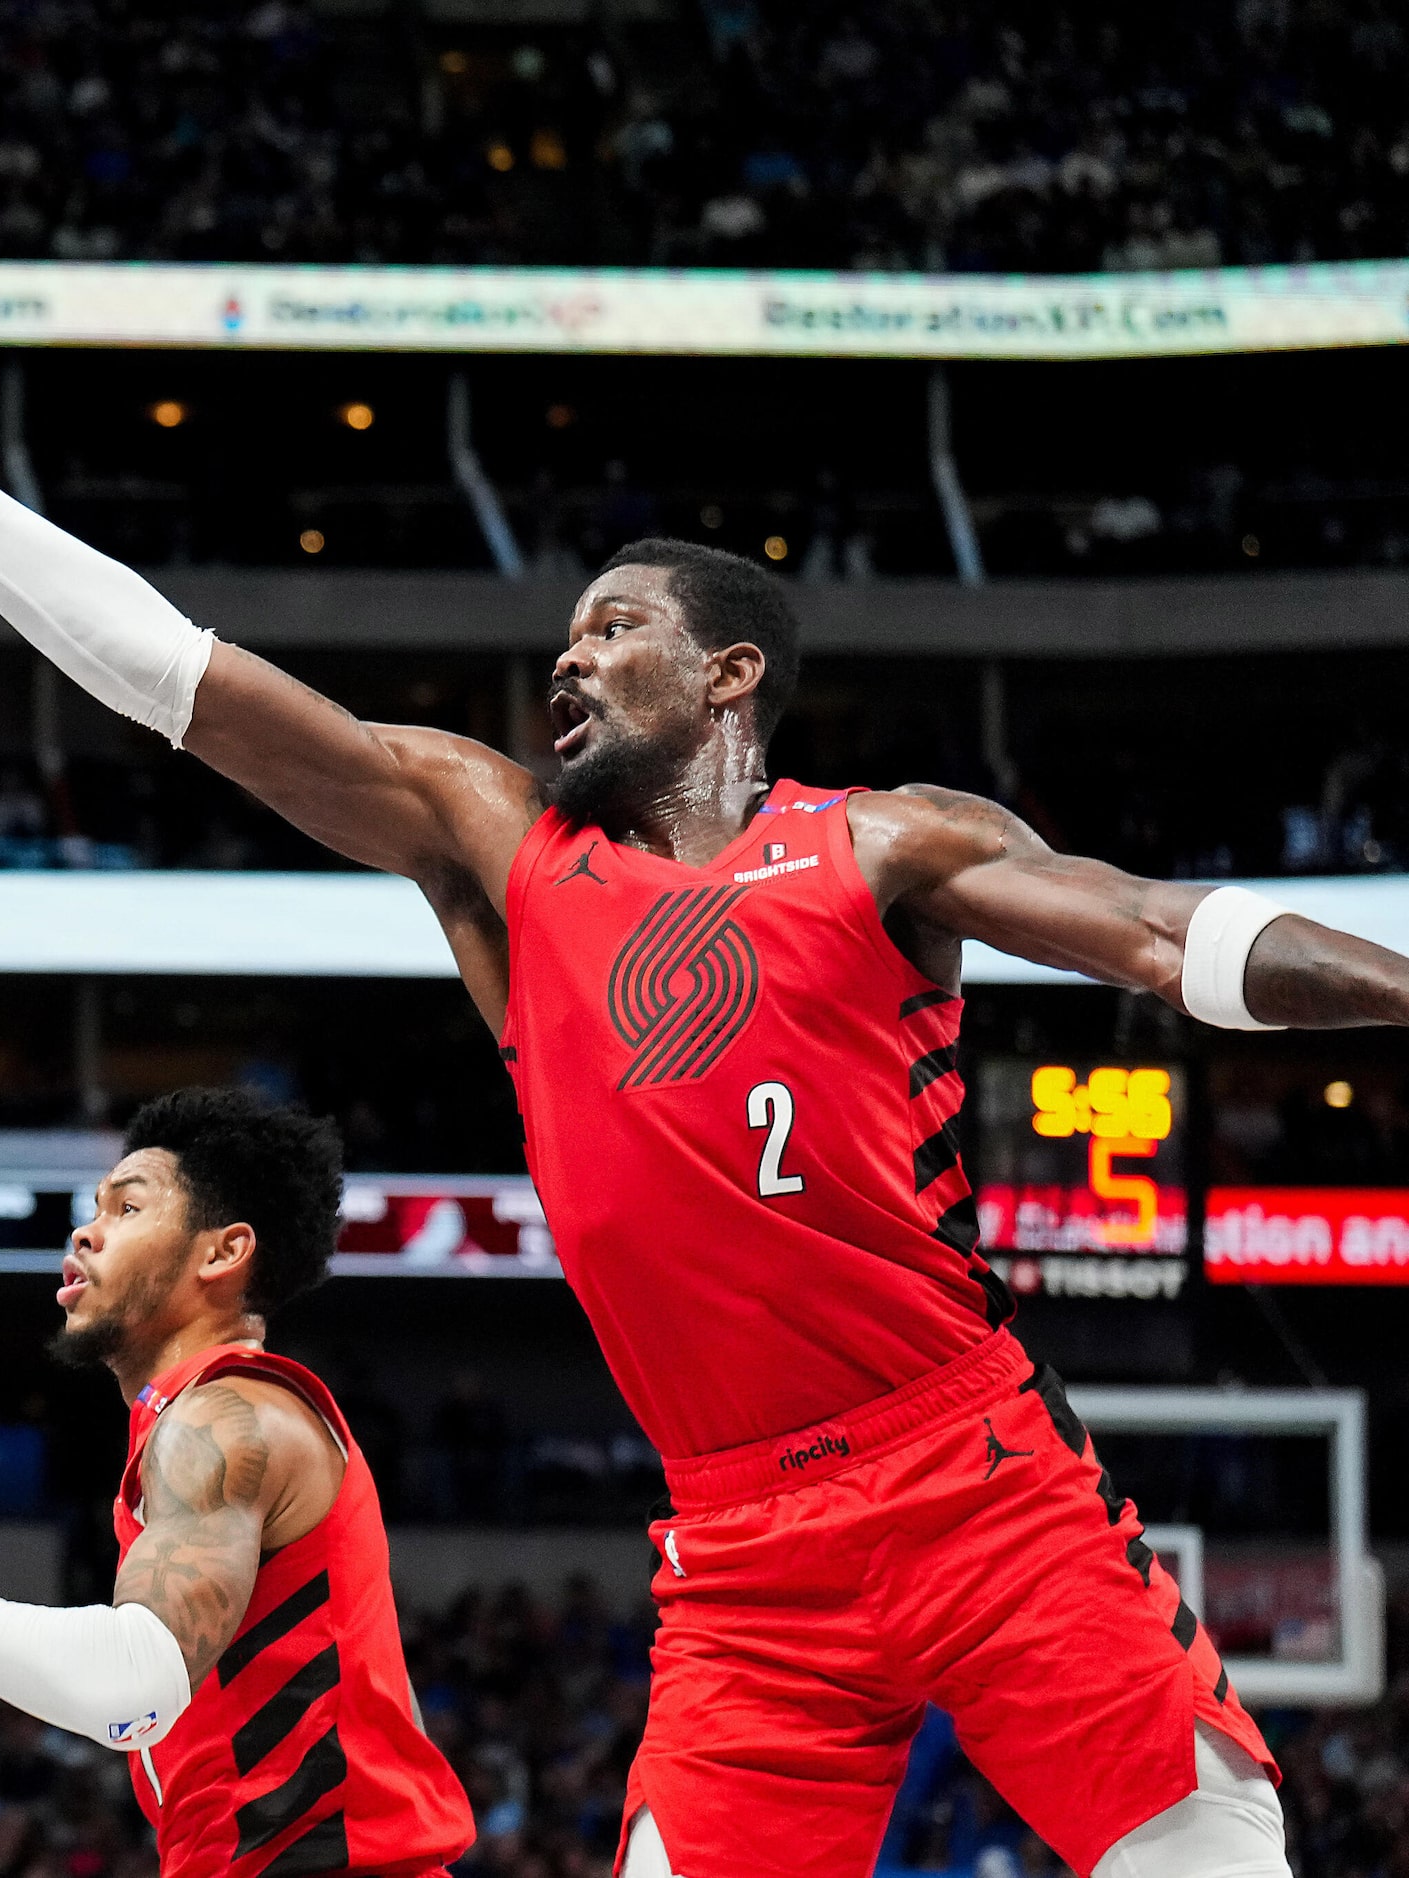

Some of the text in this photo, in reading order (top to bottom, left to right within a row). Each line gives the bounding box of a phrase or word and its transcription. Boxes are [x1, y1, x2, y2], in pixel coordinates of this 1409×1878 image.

[733, 855, 820, 884] BRIGHTSIDE
[746, 1080, 805, 1198] 2
[1089, 1138, 1159, 1246] 5
[779, 1435, 851, 1473] ripcity
